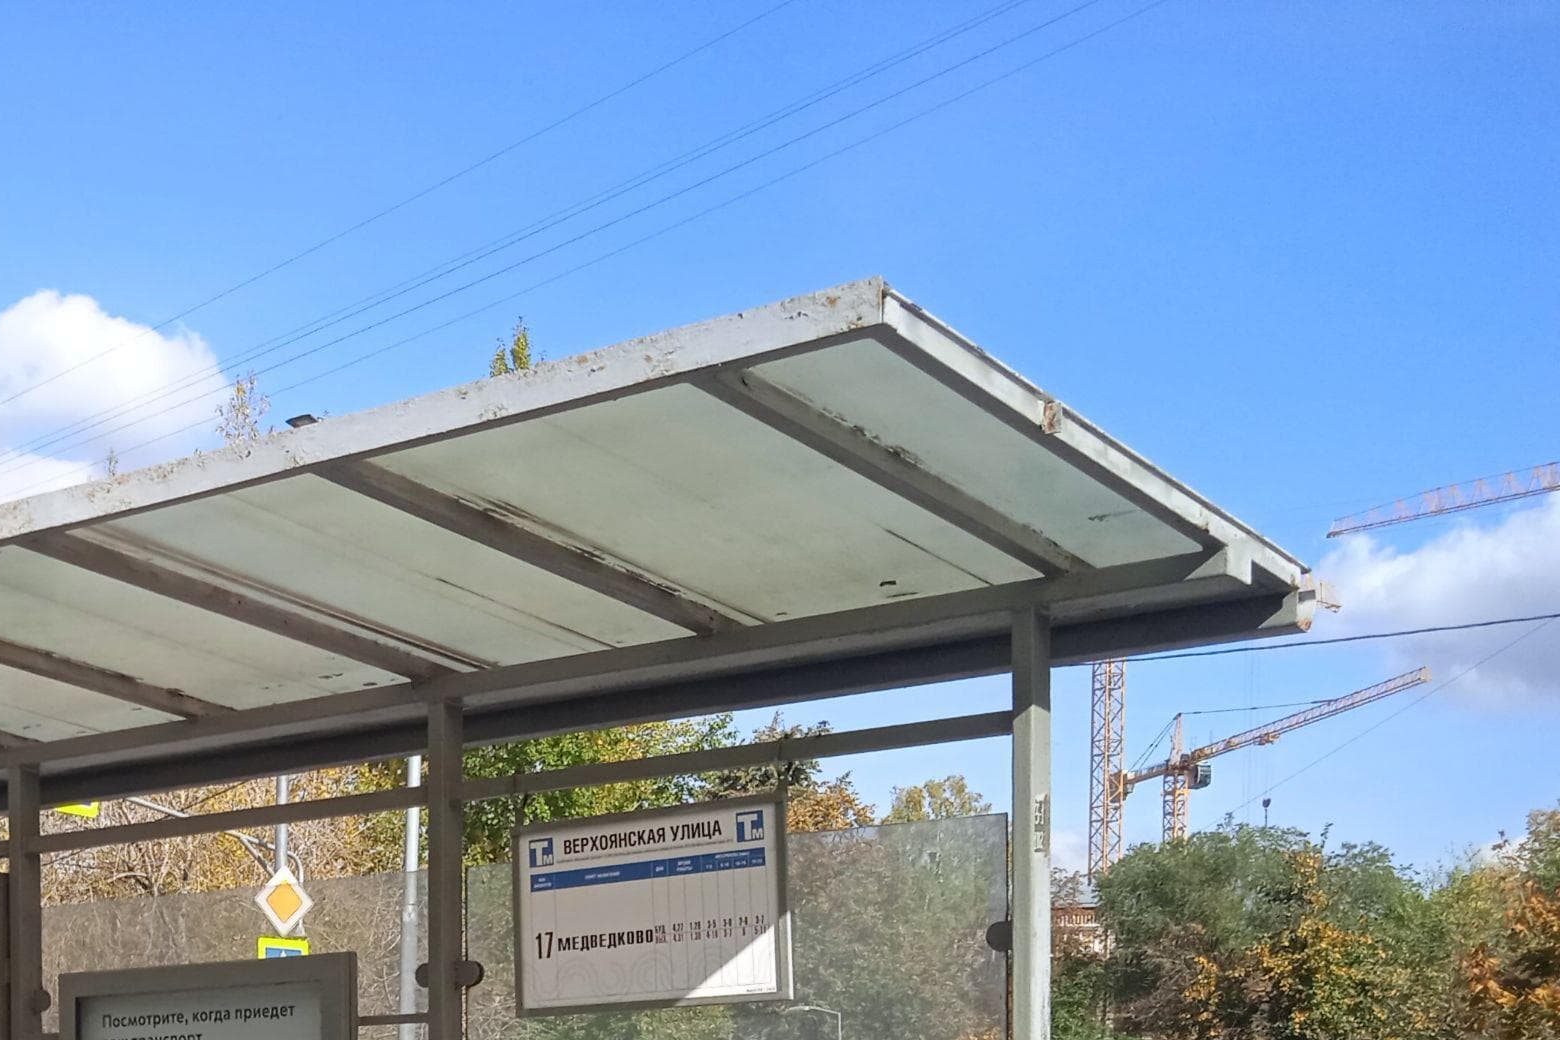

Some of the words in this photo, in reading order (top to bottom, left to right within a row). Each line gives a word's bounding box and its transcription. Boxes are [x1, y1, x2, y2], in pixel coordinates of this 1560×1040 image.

[563, 826, 666, 855] ВЕРХОЯНСКАЯ
[672, 819, 722, 842] УЛИЦА
[535, 931, 553, 960] 17
[557, 929, 654, 952] МЕДВЕДКОВО
[102, 1010, 189, 1029] Посмотрите,
[192, 1008, 231, 1026] когда
[234, 1004, 296, 1023] приедет
